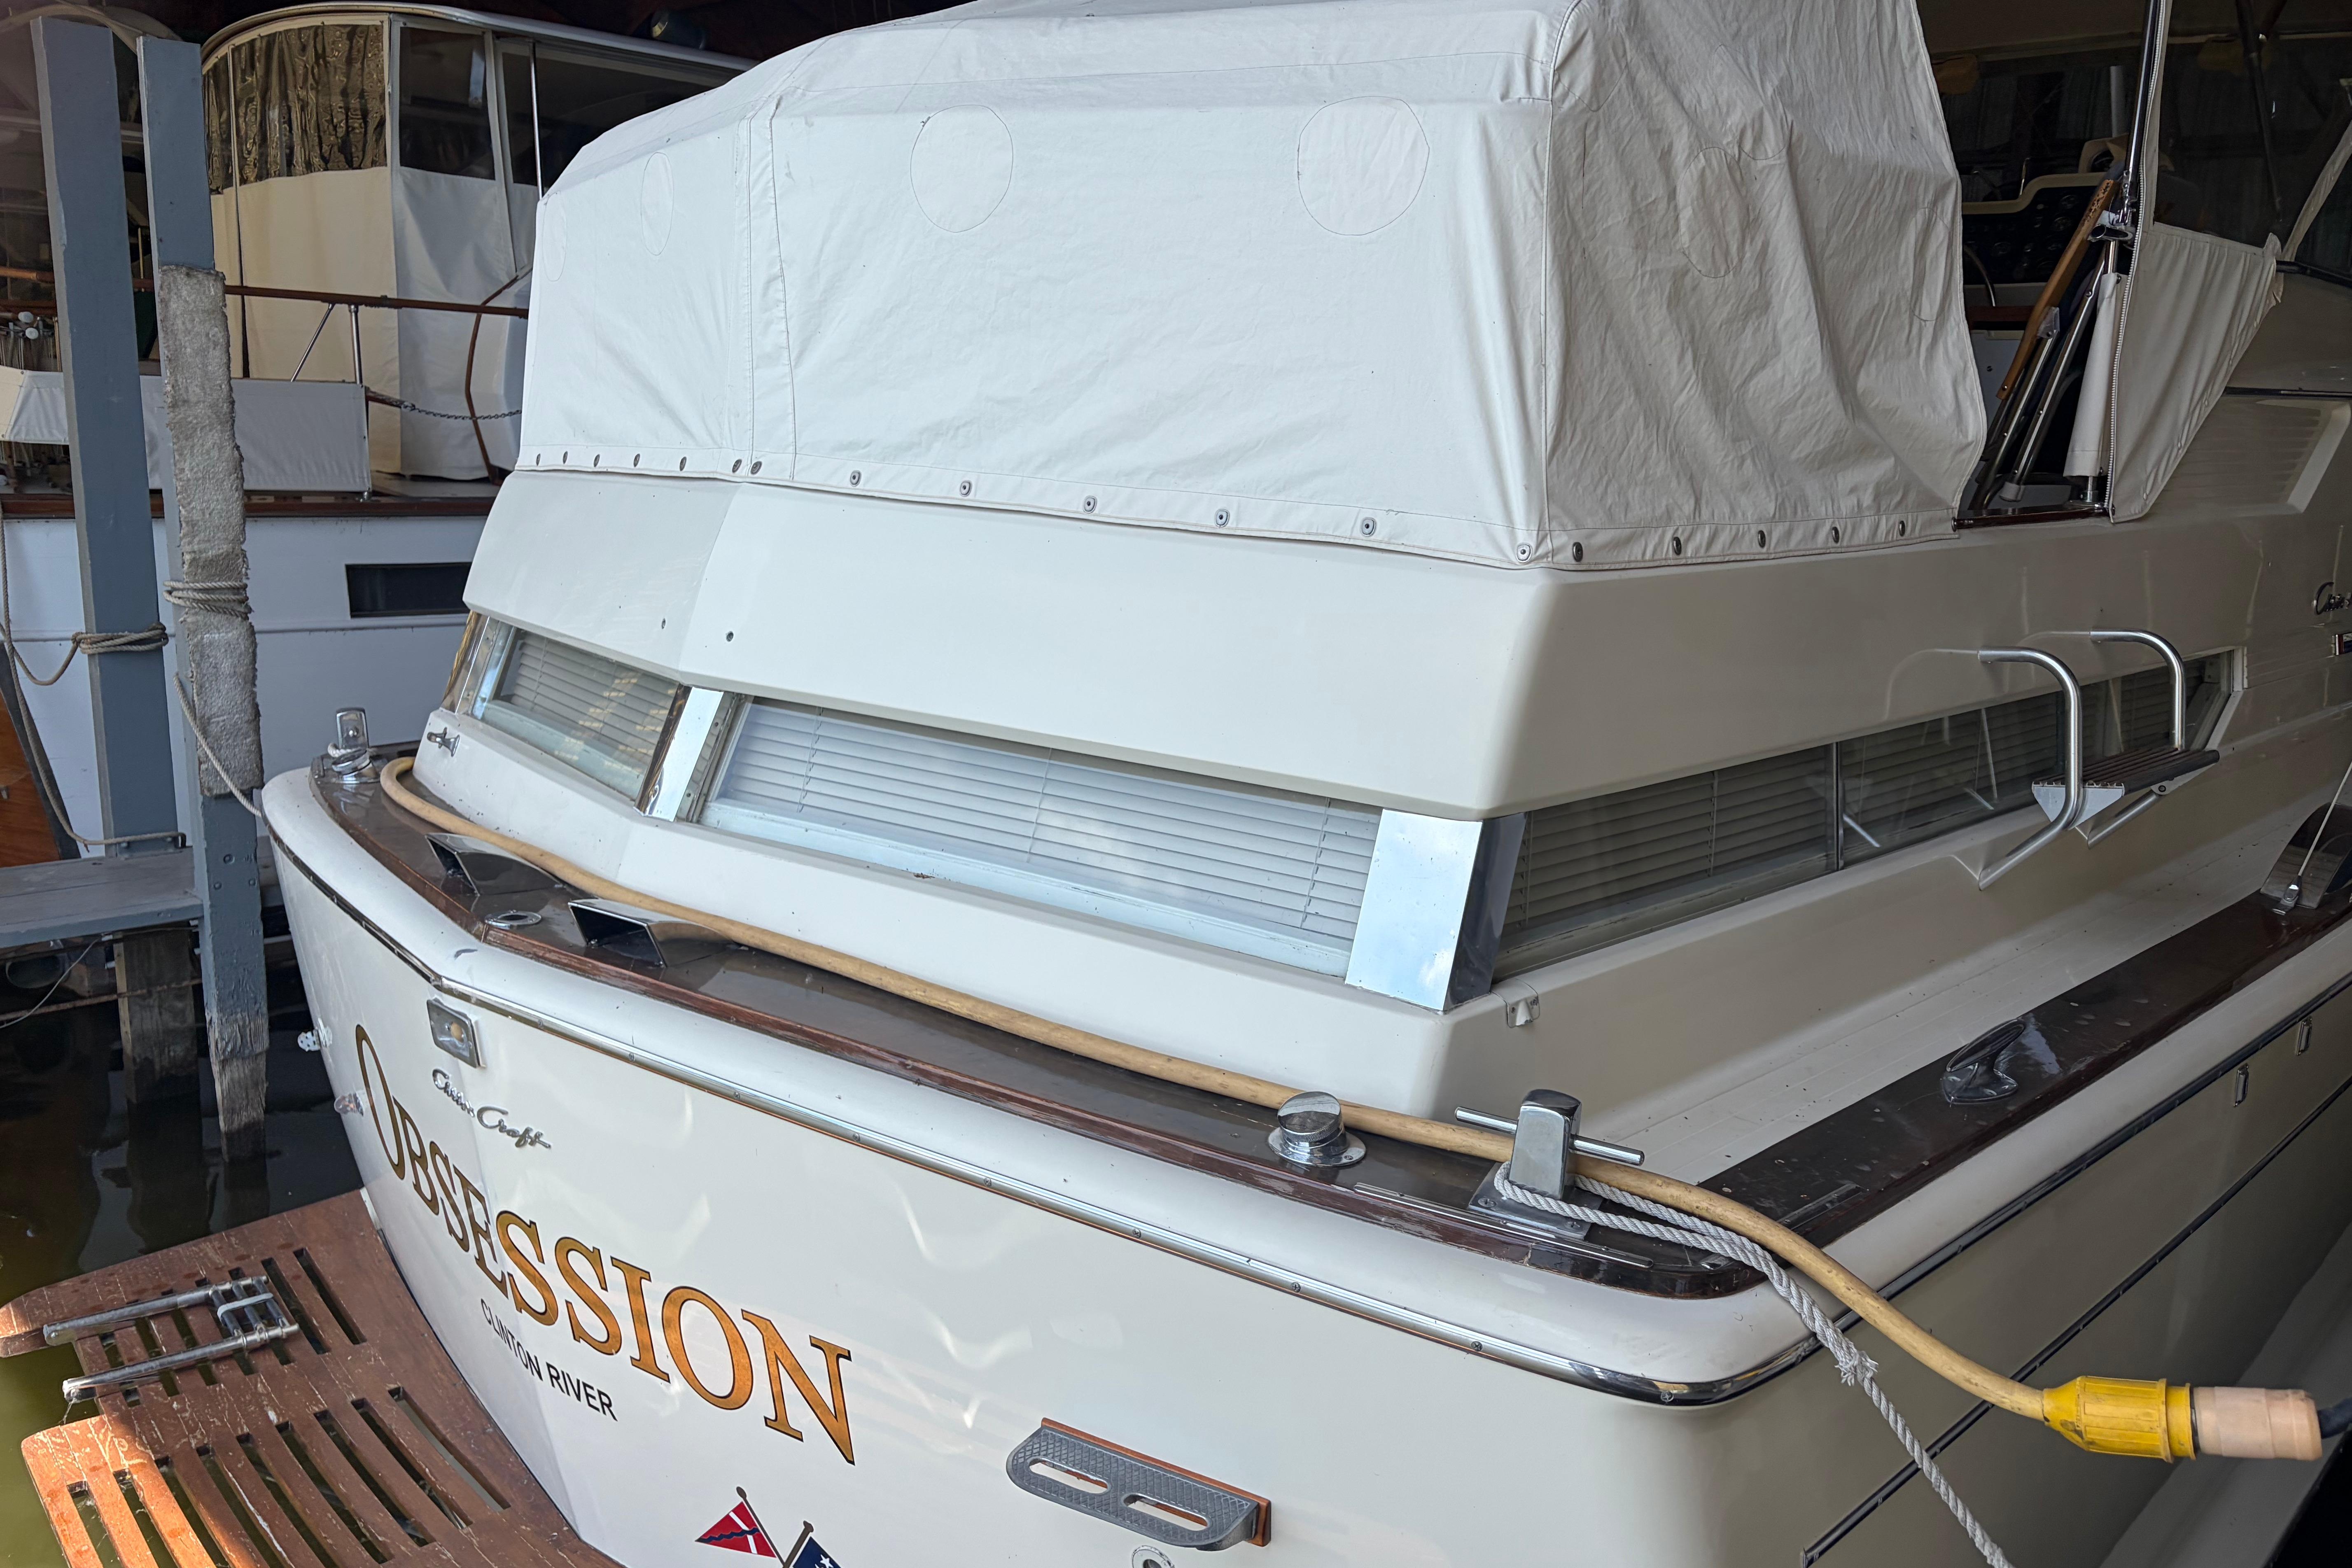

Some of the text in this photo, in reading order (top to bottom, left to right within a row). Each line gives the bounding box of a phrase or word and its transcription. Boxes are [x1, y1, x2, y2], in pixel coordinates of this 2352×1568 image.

[477, 1105, 552, 1148] Craft
[356, 1024, 856, 1466] OBSESSION
[481, 1298, 618, 1422] CLINTON RIVER
